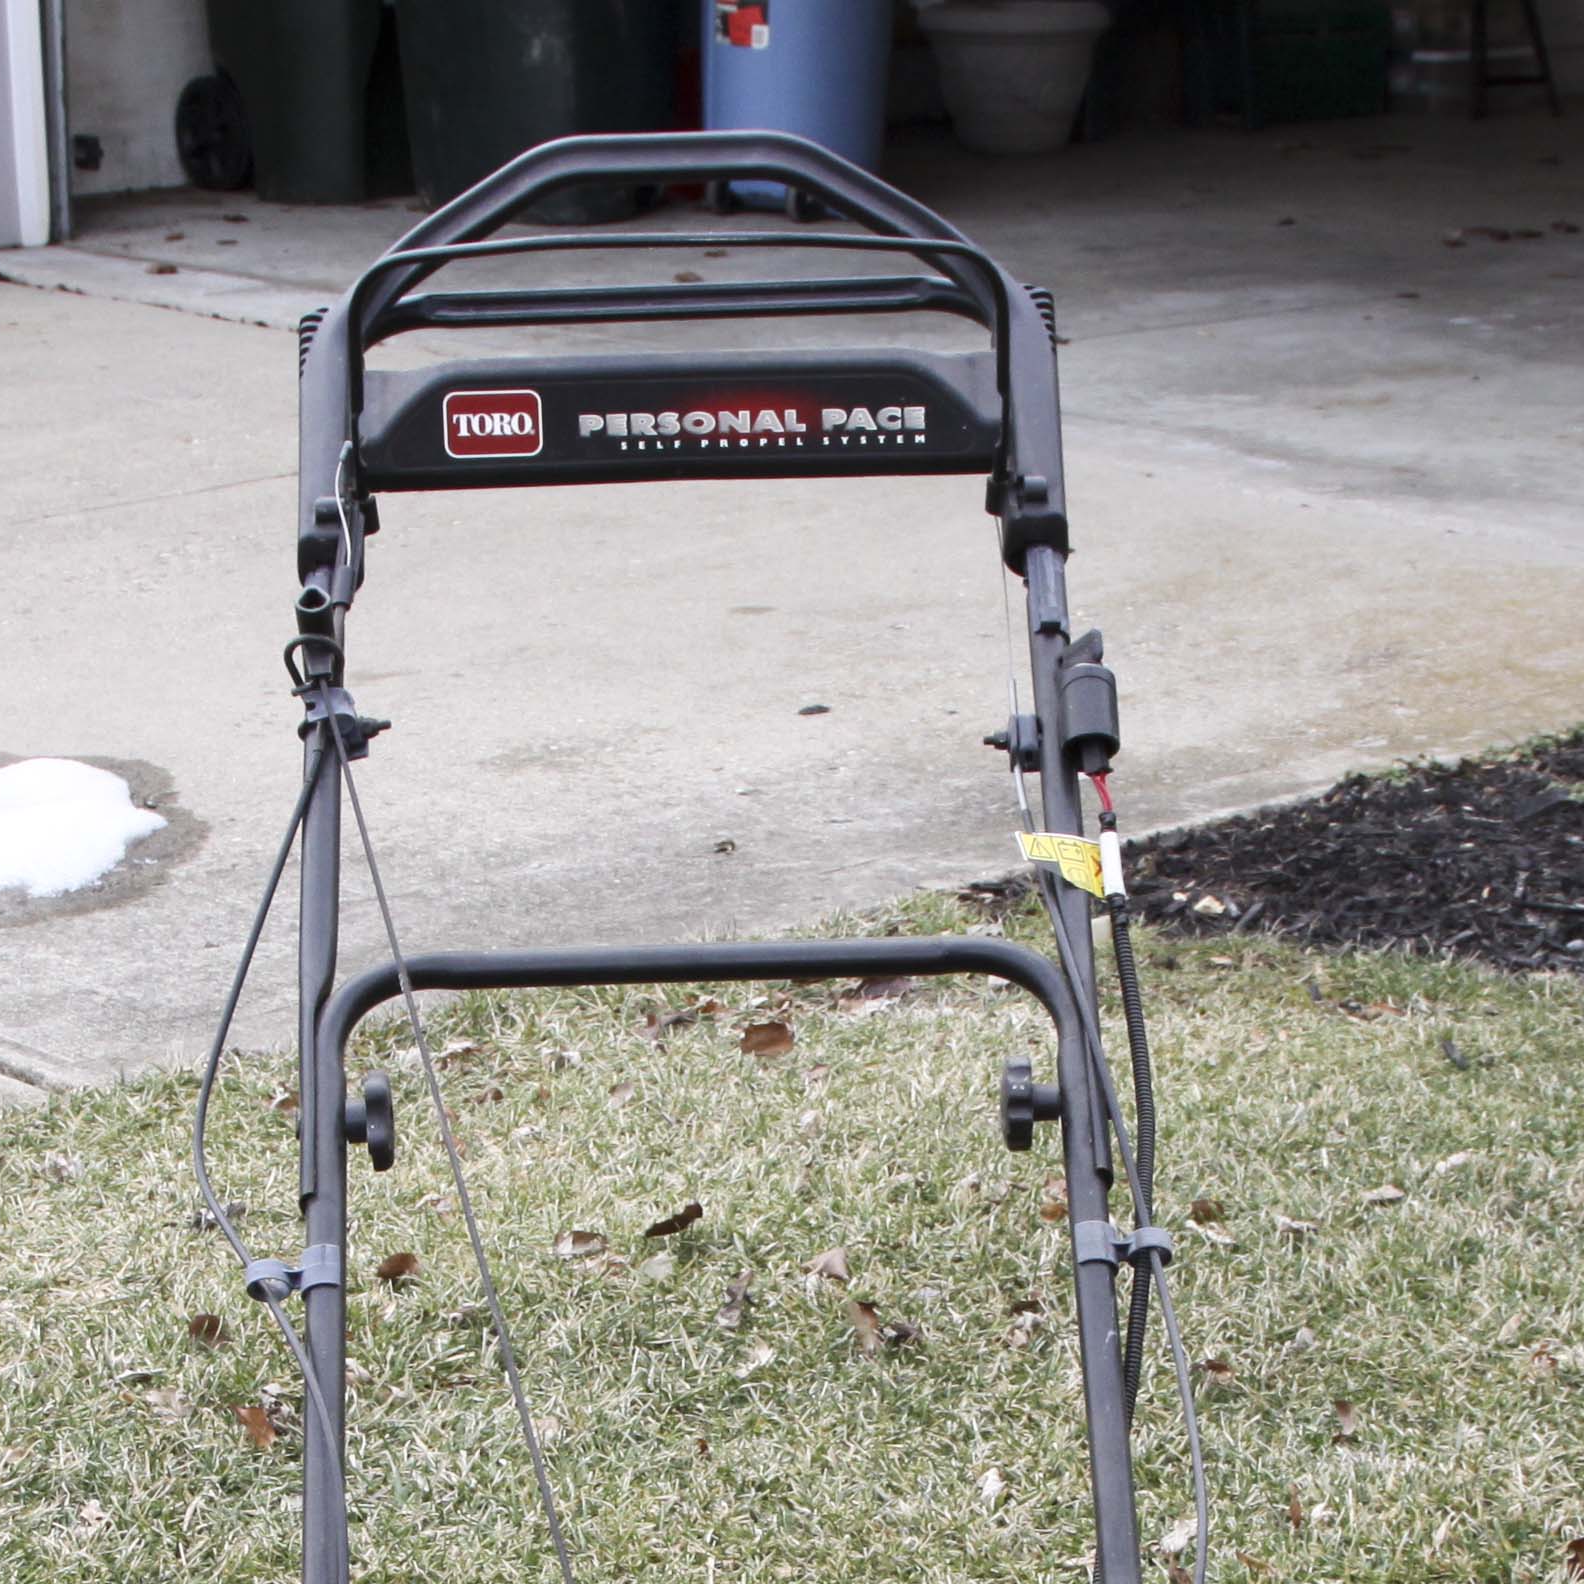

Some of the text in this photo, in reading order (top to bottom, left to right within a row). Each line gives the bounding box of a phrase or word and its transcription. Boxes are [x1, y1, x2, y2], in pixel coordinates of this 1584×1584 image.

[452, 412, 535, 437] TORO
[578, 406, 926, 437] PERSONAL PACE
[620, 434, 926, 450] SELF PROPEL SYSTEM
